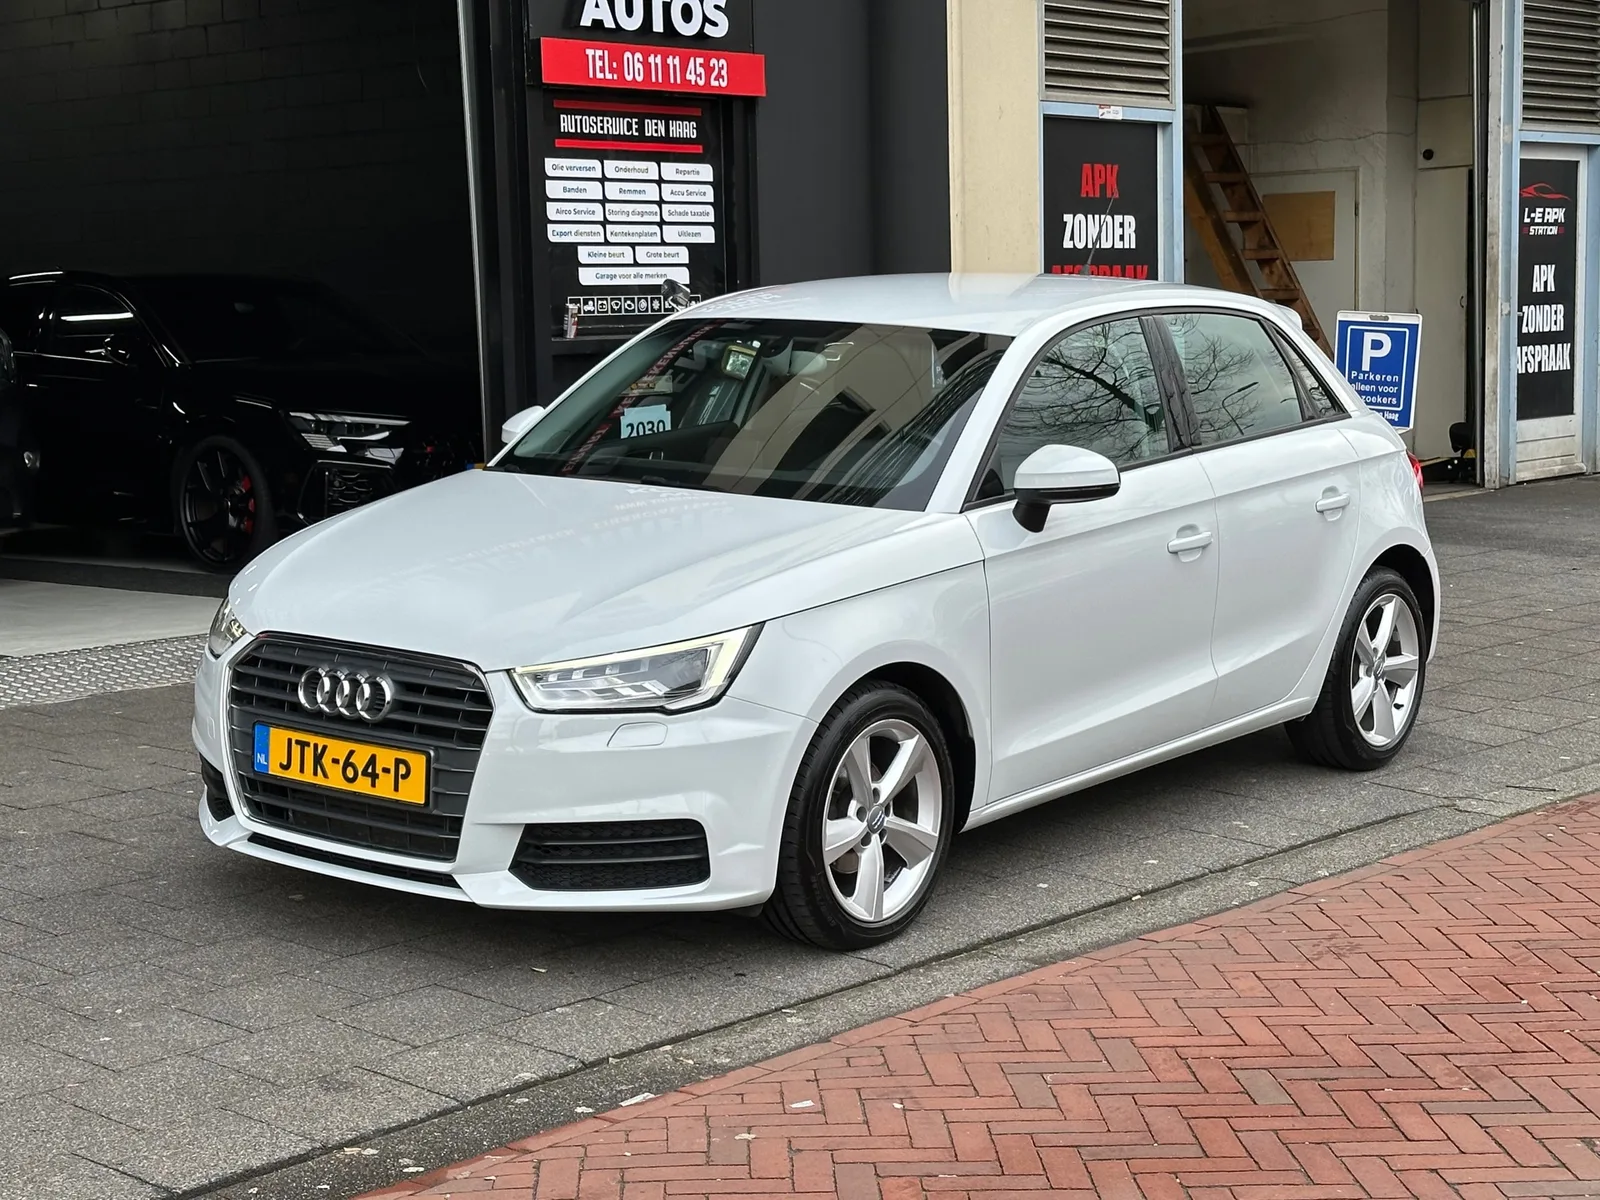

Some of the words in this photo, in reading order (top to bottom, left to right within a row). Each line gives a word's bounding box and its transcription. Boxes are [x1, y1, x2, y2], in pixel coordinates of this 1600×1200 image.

[579, 0, 730, 38] AUTOS
[585, 48, 618, 80] TEL:
[623, 51, 644, 83] 06
[648, 53, 663, 84] 11
[666, 55, 681, 84] 11
[685, 57, 706, 87] 45
[709, 58, 729, 88] 23
[560, 114, 639, 136] AUTOSERVICE
[645, 118, 665, 137] DEN
[669, 120, 697, 138] HAAG
[552, 163, 565, 171] Olie
[566, 165, 596, 173] verversen
[614, 165, 649, 174] Onderhoud
[1080, 163, 1119, 198] APK
[562, 186, 587, 194] Banden
[618, 187, 646, 195] Remmen
[670, 189, 685, 197] Accu
[686, 189, 707, 197] Service
[573, 208, 596, 216] Service
[607, 209, 630, 218] Storing
[631, 208, 658, 218] diagnose
[667, 209, 689, 217] Schade
[690, 209, 710, 217] taxatie
[1523, 207, 1544, 223] L-E
[1544, 207, 1566, 223] APK
[552, 229, 573, 238] Export
[574, 229, 601, 237] diensten
[610, 230, 658, 239] Kentekenplaten
[677, 230, 701, 239] Uitlezen
[1062, 213, 1136, 249] ZONDER
[1529, 225, 1559, 235] STATION
[595, 272, 617, 280] Garage
[1532, 264, 1556, 293] APK
[1521, 303, 1565, 334] ZONDER
[1361, 331, 1392, 372] P
[1351, 370, 1399, 382] Parkeren
[1377, 384, 1399, 393] voor
[1383, 411, 1400, 421] Haag
[256, 753, 268, 765] NL
[279, 737, 413, 793] JTK-64-P
